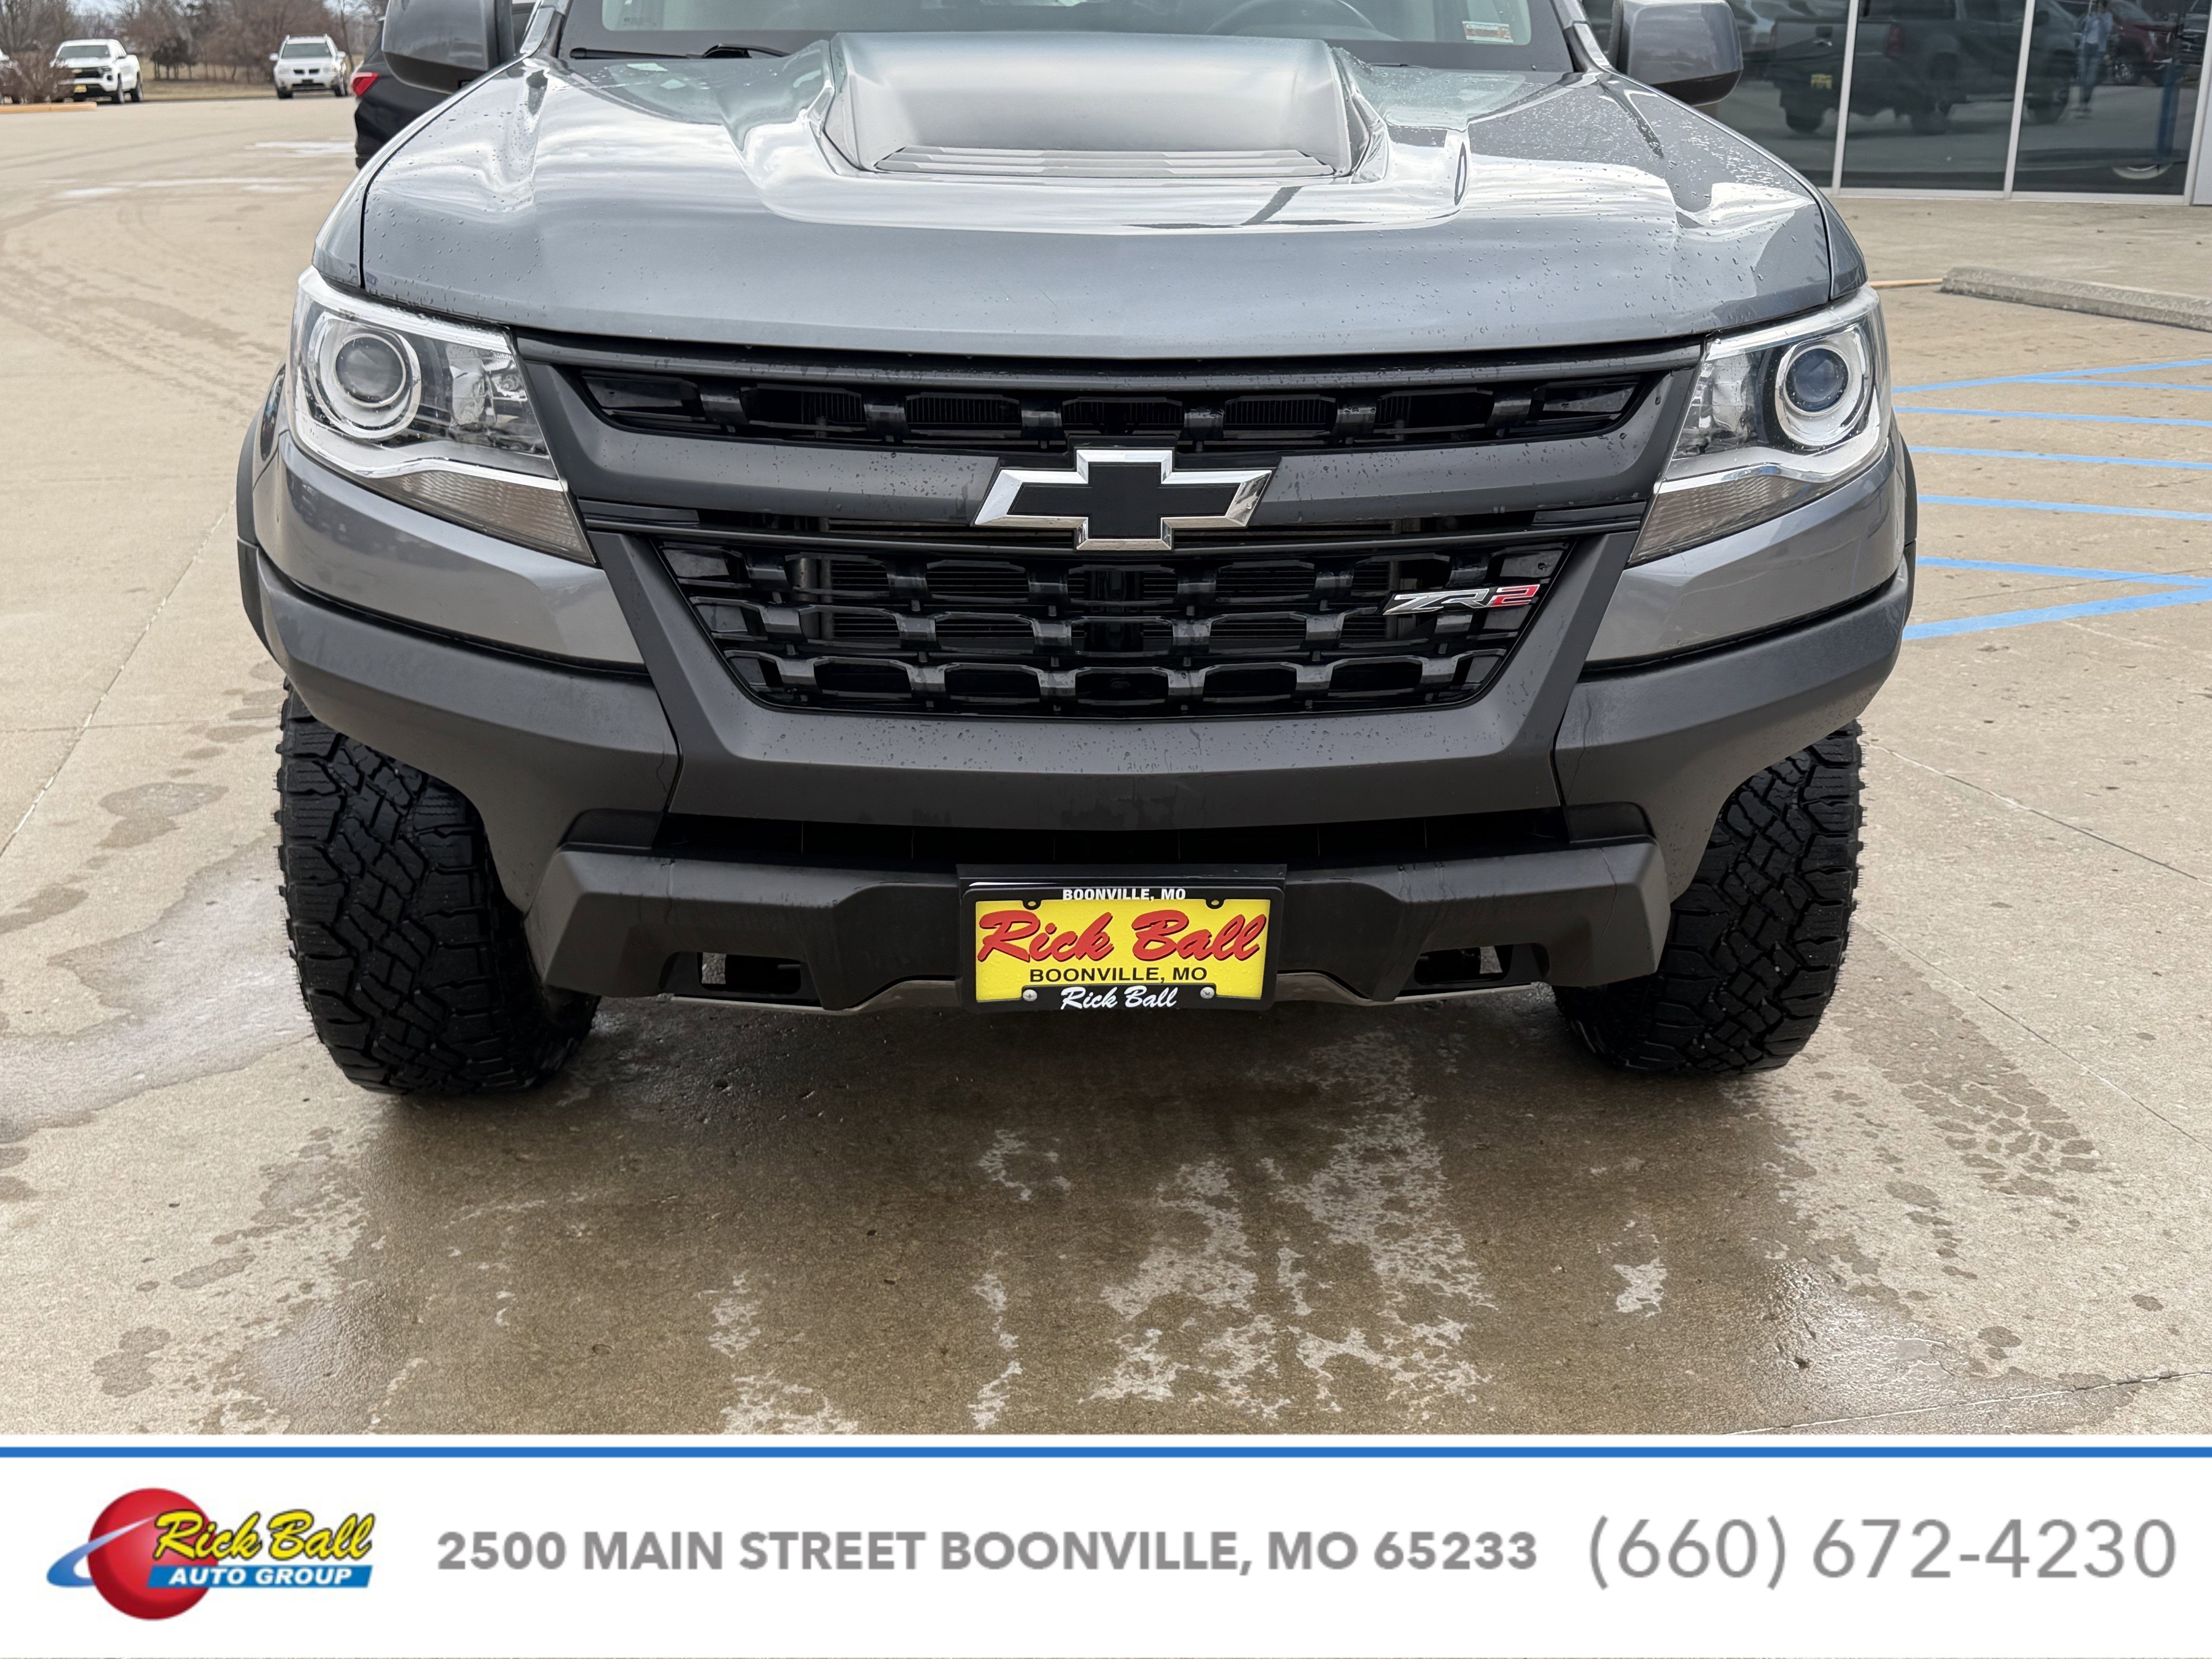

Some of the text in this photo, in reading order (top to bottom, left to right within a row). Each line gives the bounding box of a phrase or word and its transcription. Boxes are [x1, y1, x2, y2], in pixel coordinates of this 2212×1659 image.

[1383, 584, 1540, 615] ZR2
[1063, 888, 1186, 901] BOONVILLE, MO
[977, 909, 1266, 963] Rick Ball
[1030, 967, 1207, 983] BOONVILLE, MO
[1061, 987, 1177, 1010] Rick Ball
